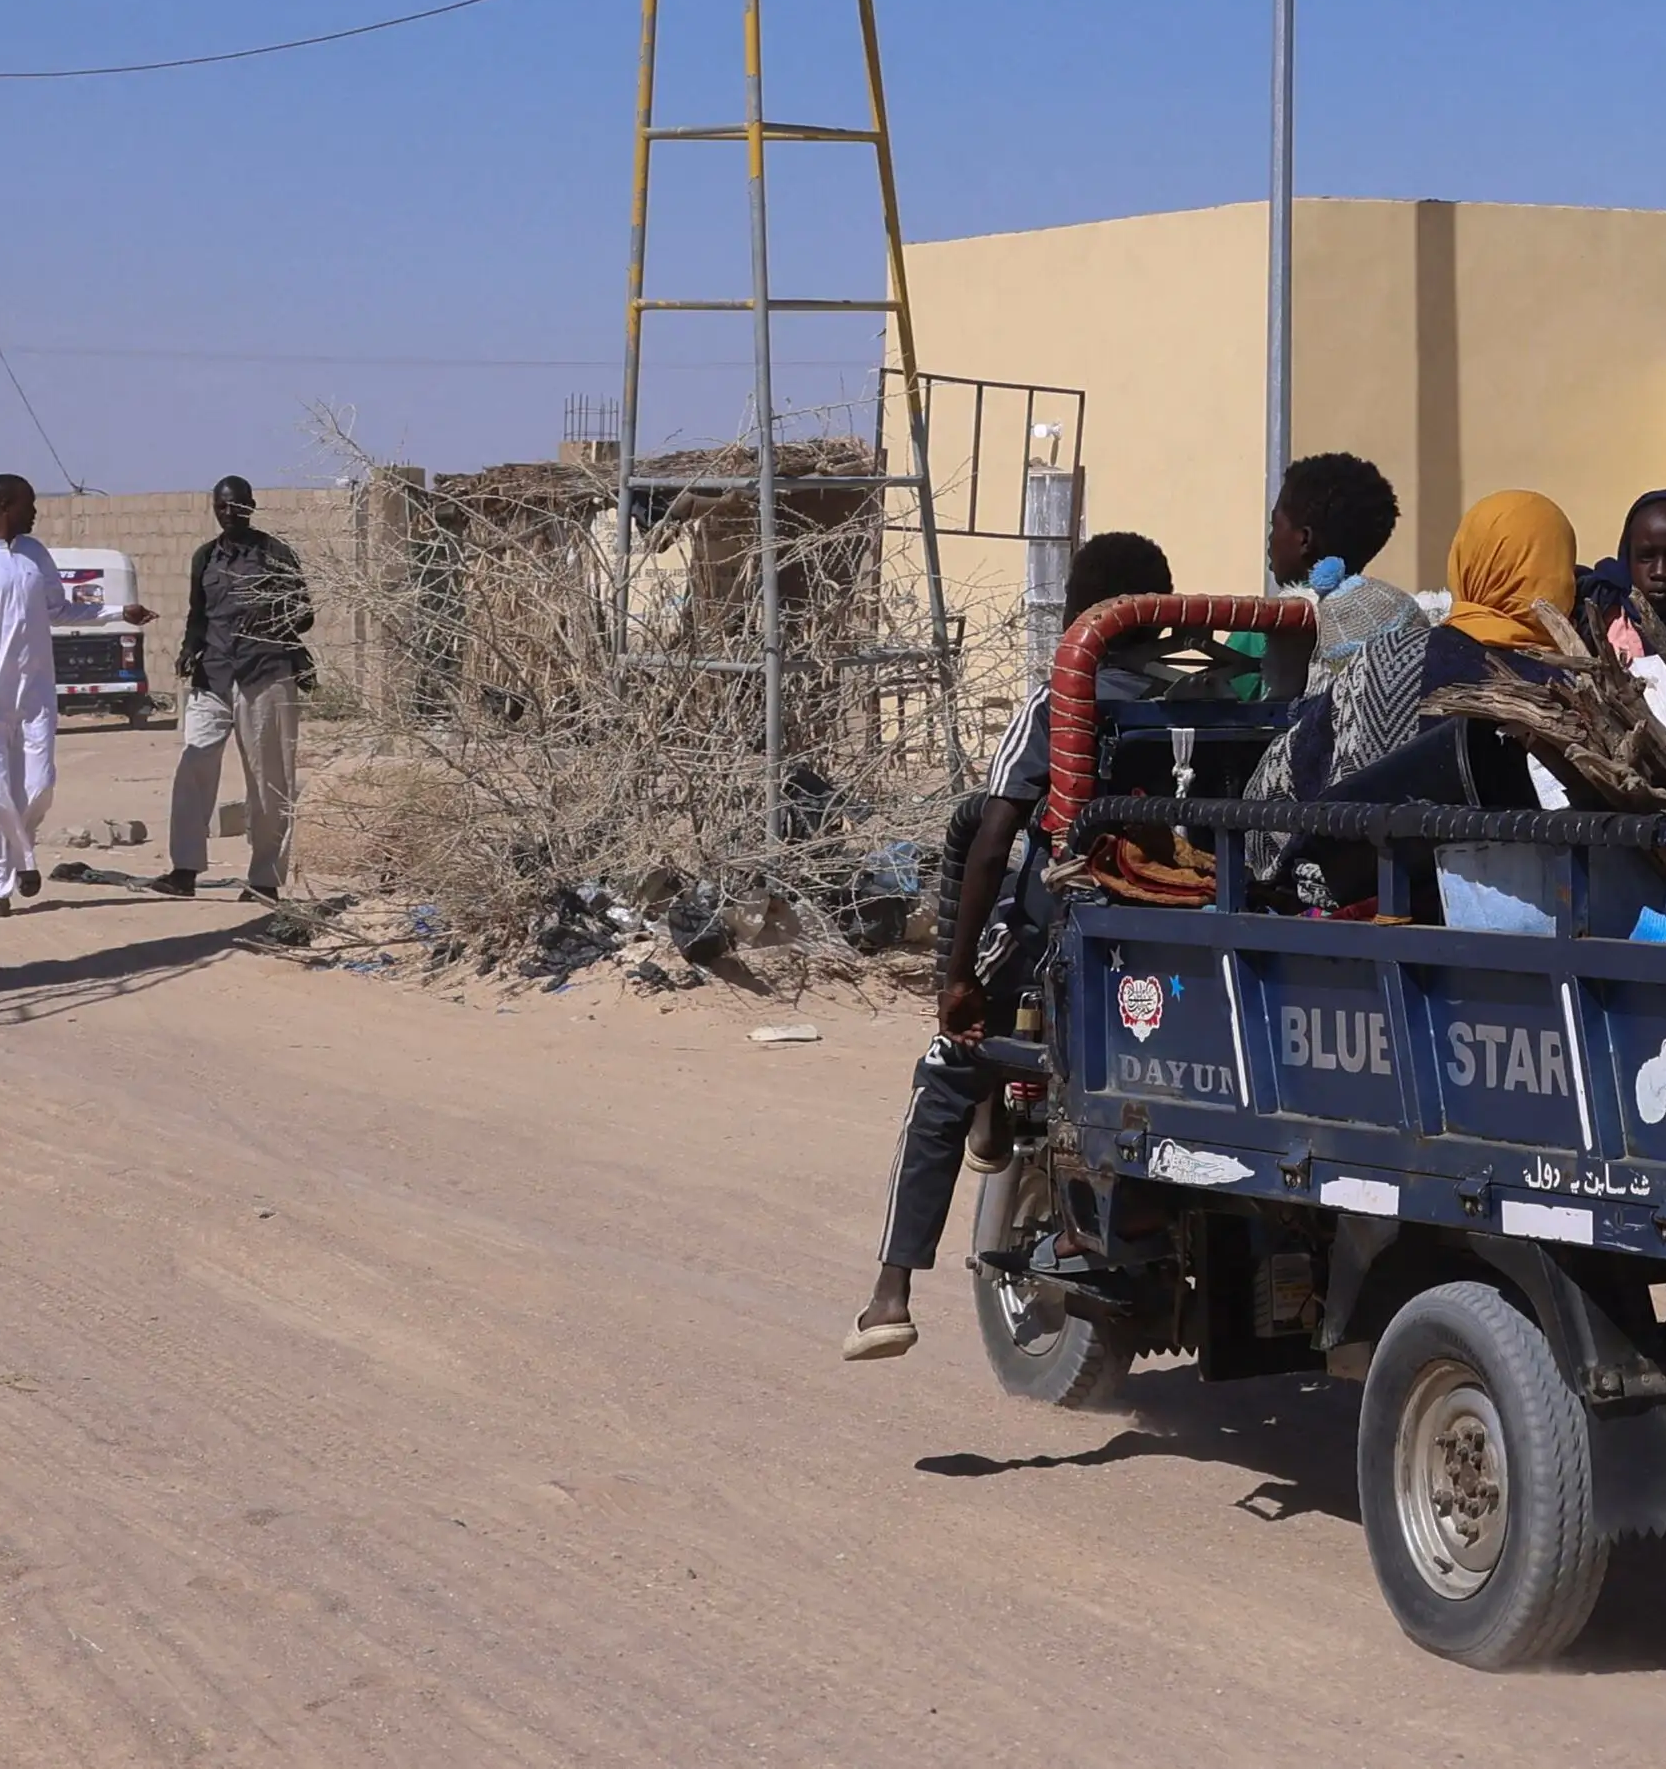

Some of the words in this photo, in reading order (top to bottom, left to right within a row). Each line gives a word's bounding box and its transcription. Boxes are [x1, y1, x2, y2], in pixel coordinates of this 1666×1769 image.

[57, 570, 77, 579] VS
[1281, 1005, 1392, 1076] BLUE
[1445, 1021, 1569, 1097] STAR
